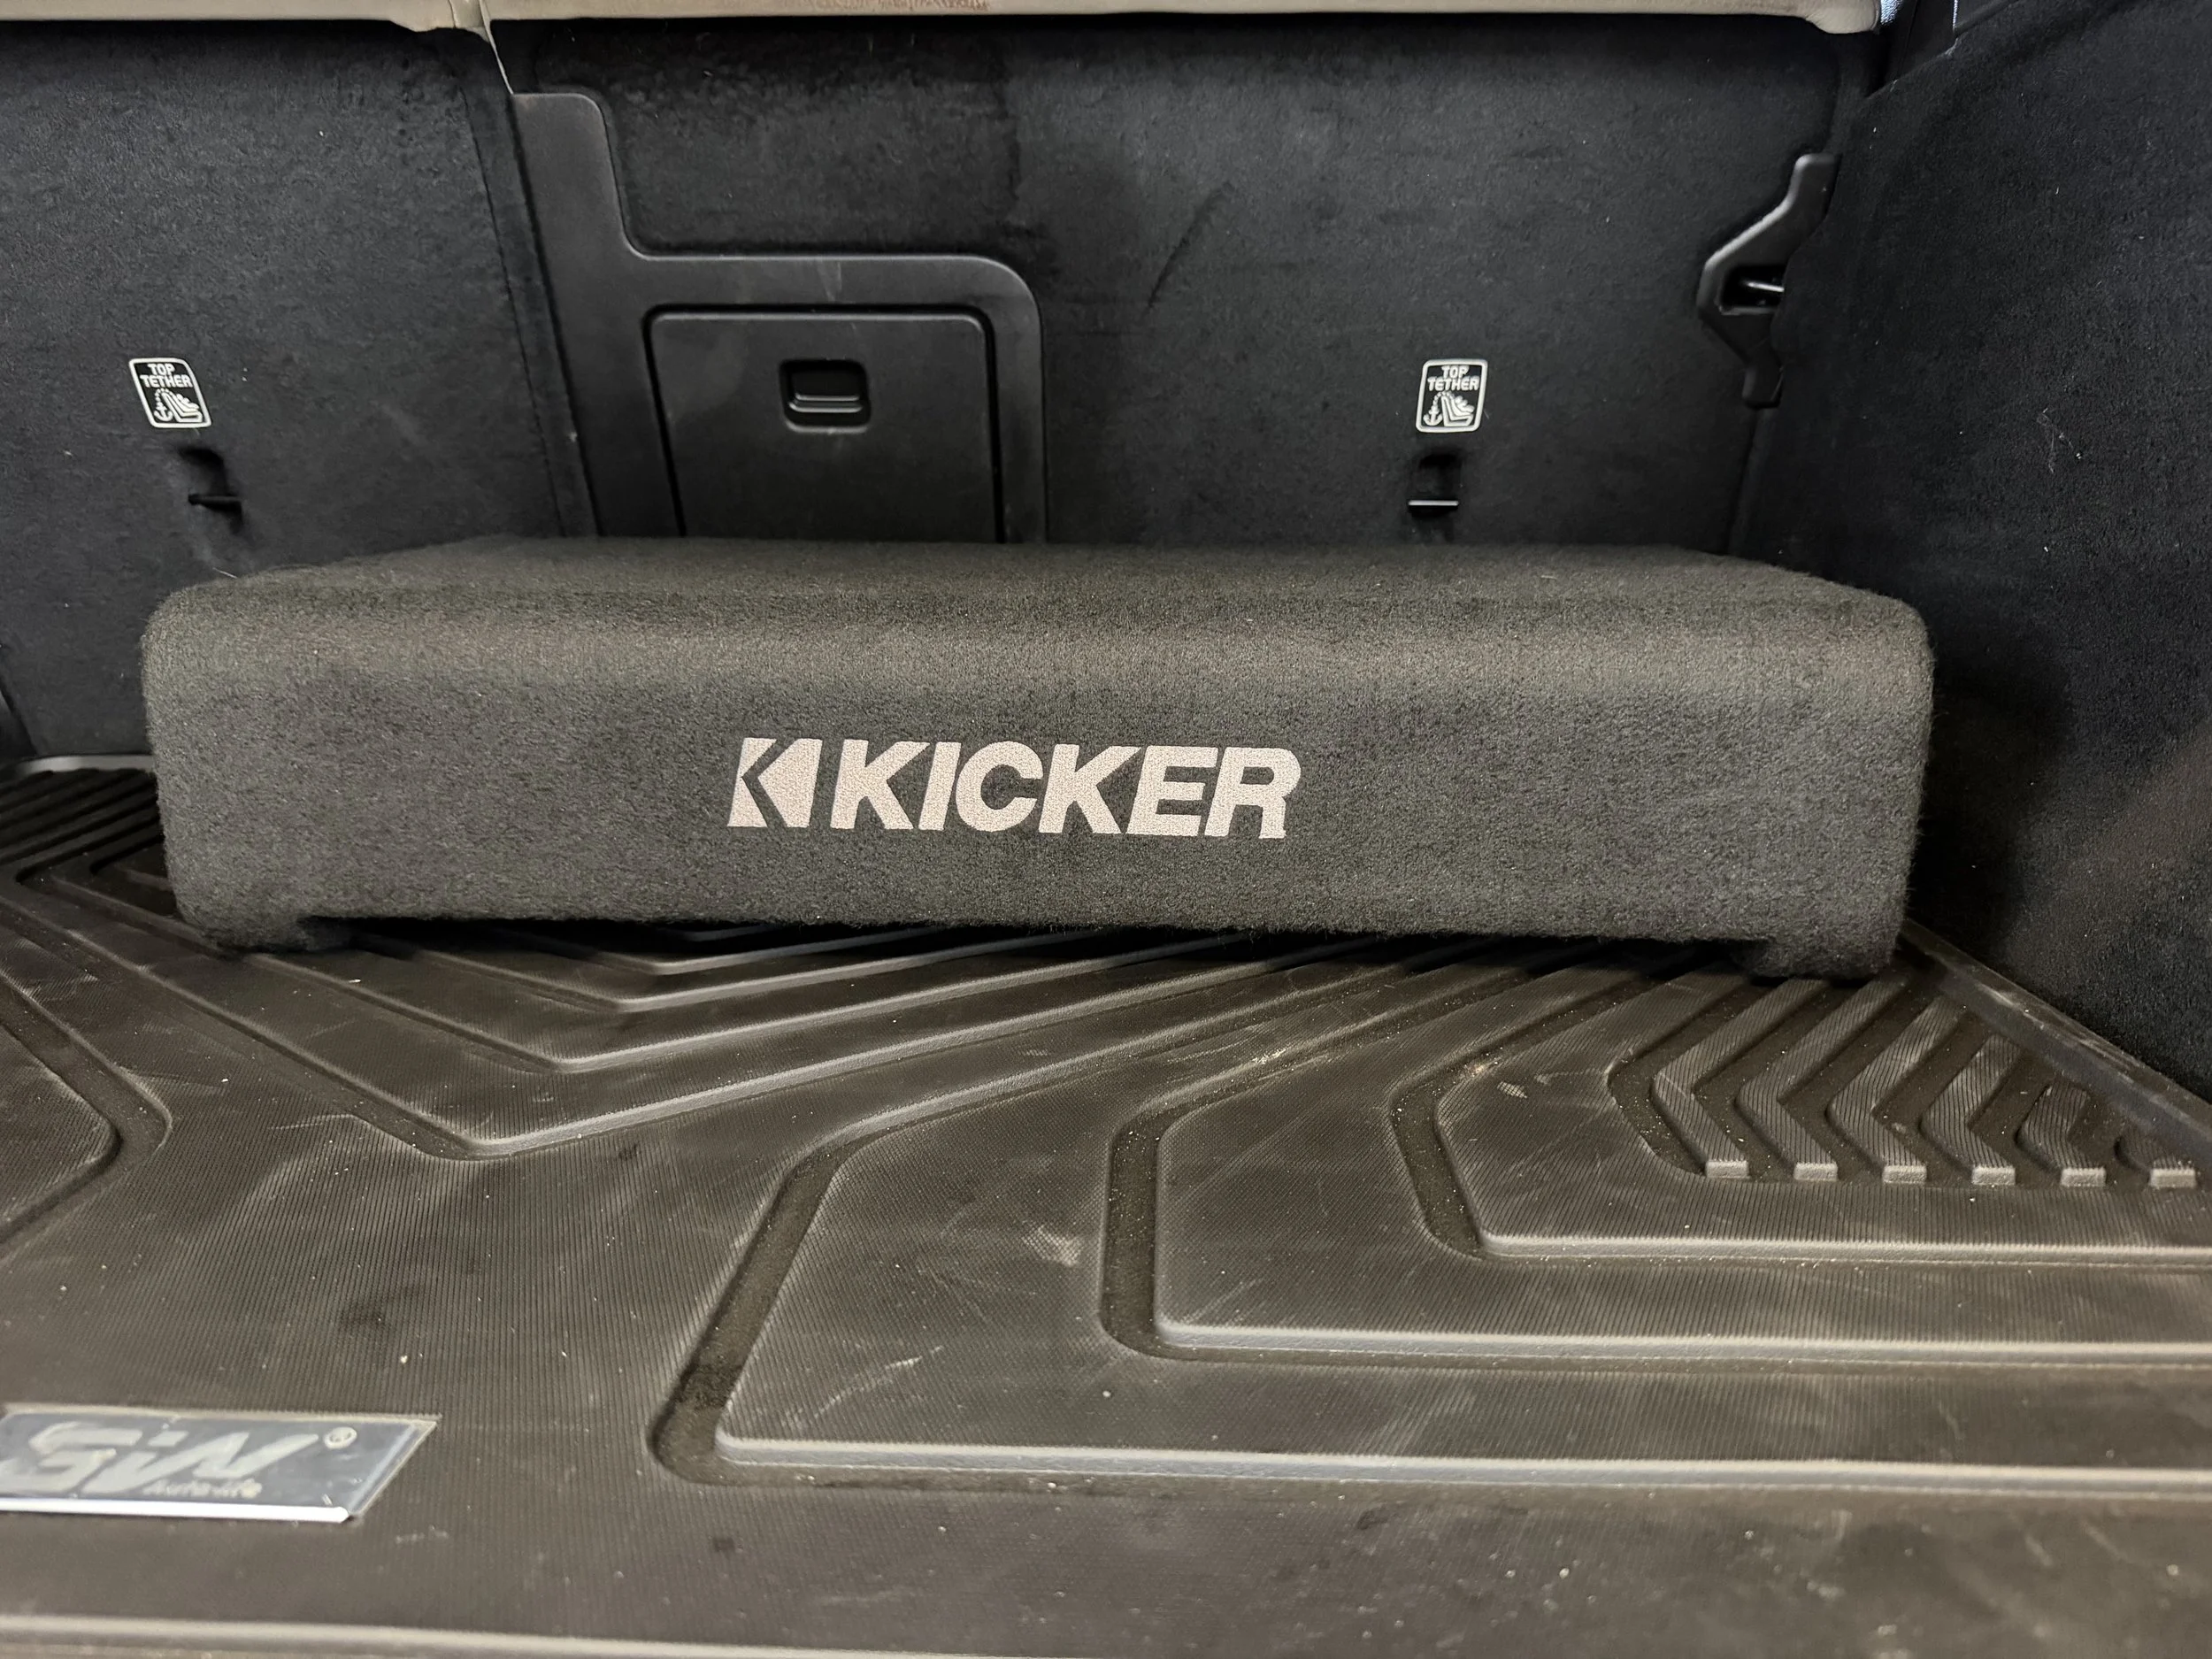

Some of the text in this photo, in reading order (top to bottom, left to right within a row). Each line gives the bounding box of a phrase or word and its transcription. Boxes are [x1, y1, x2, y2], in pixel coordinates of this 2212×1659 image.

[148, 363, 175, 375] TOP
[1441, 365, 1470, 379] TOP
[140, 374, 193, 388] TETHER
[1427, 375, 1480, 391] TETHER
[830, 738, 1302, 839] KICKER
